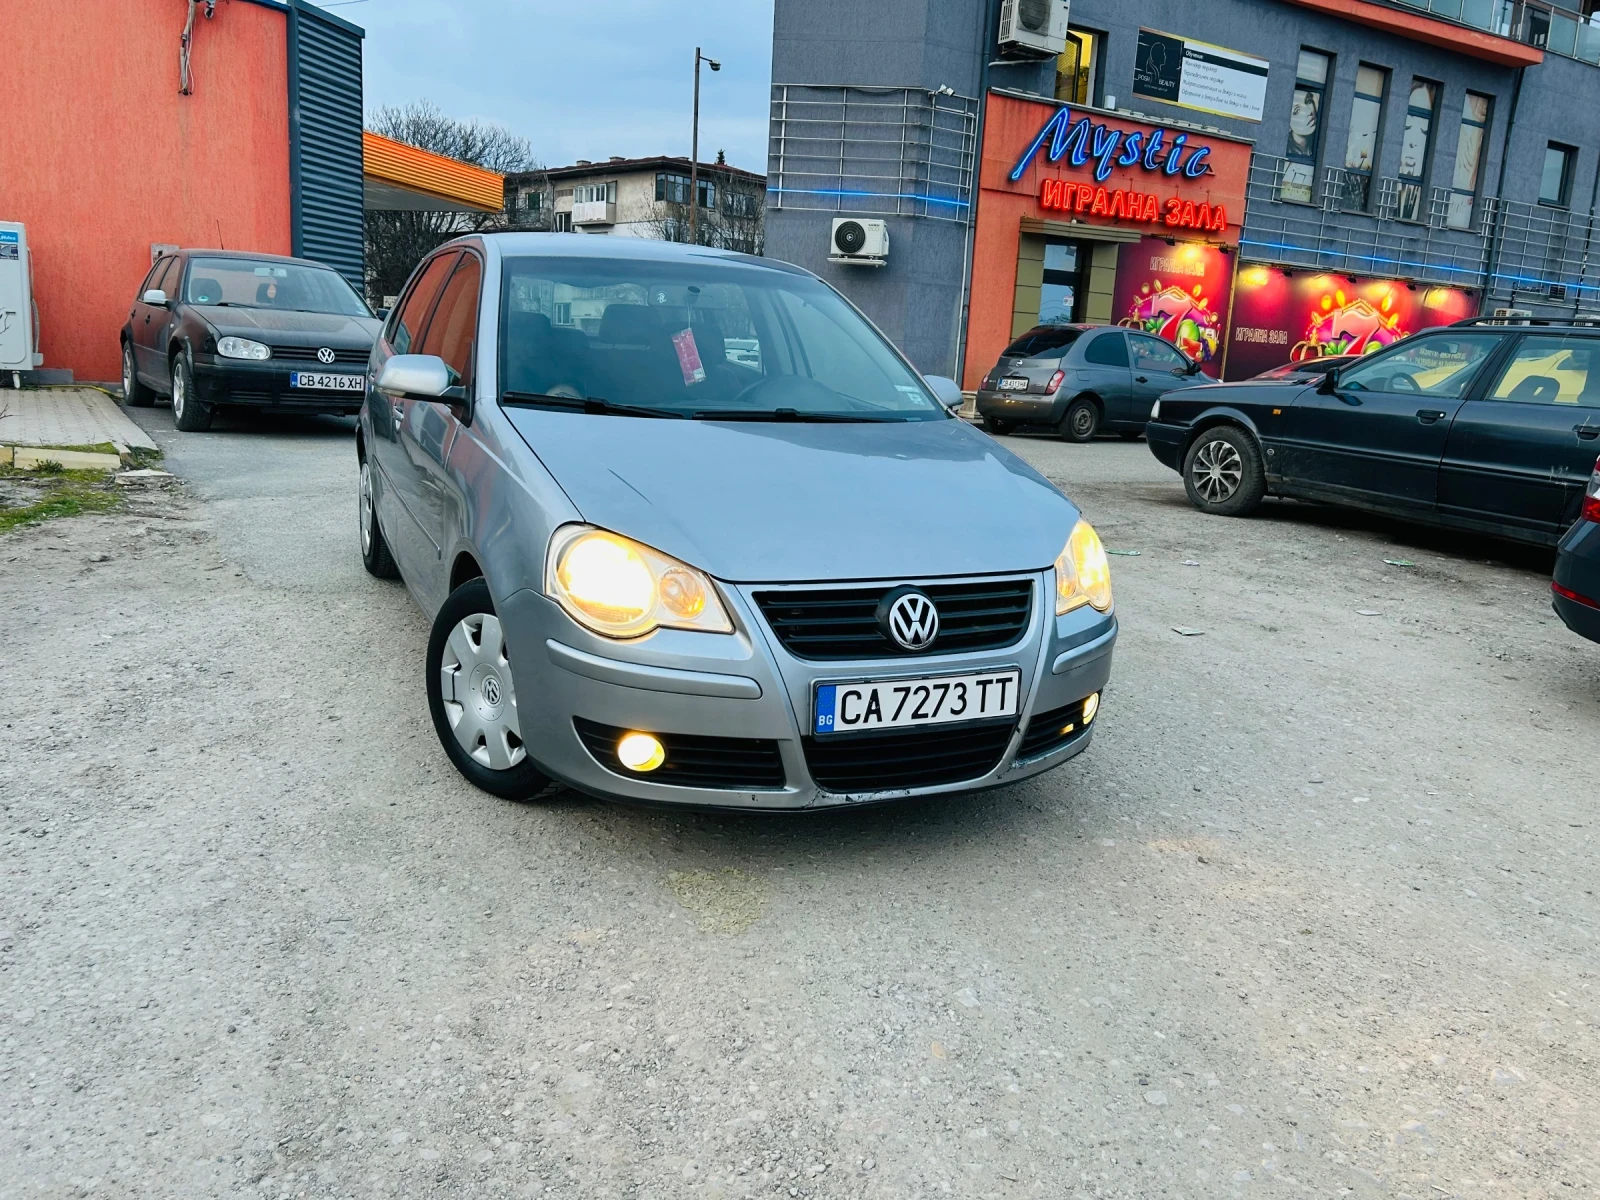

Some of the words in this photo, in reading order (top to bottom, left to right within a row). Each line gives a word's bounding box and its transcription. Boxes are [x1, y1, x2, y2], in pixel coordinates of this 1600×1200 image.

[1158, 79, 1176, 88] BEAUTY
[1008, 105, 1211, 182] Mystic
[1041, 178, 1159, 223] ИГРАЛНА
[1165, 197, 1228, 232] ЗАЛА
[1235, 326, 1268, 343] ИГРАЛНА
[1269, 329, 1288, 345] ЗАЛА
[299, 375, 315, 387] CB
[317, 376, 346, 389] 4216
[347, 377, 362, 389] XH
[840, 688, 883, 725] CA
[891, 682, 967, 722] 7273
[975, 676, 1014, 713] TT
[818, 714, 833, 726] BG
